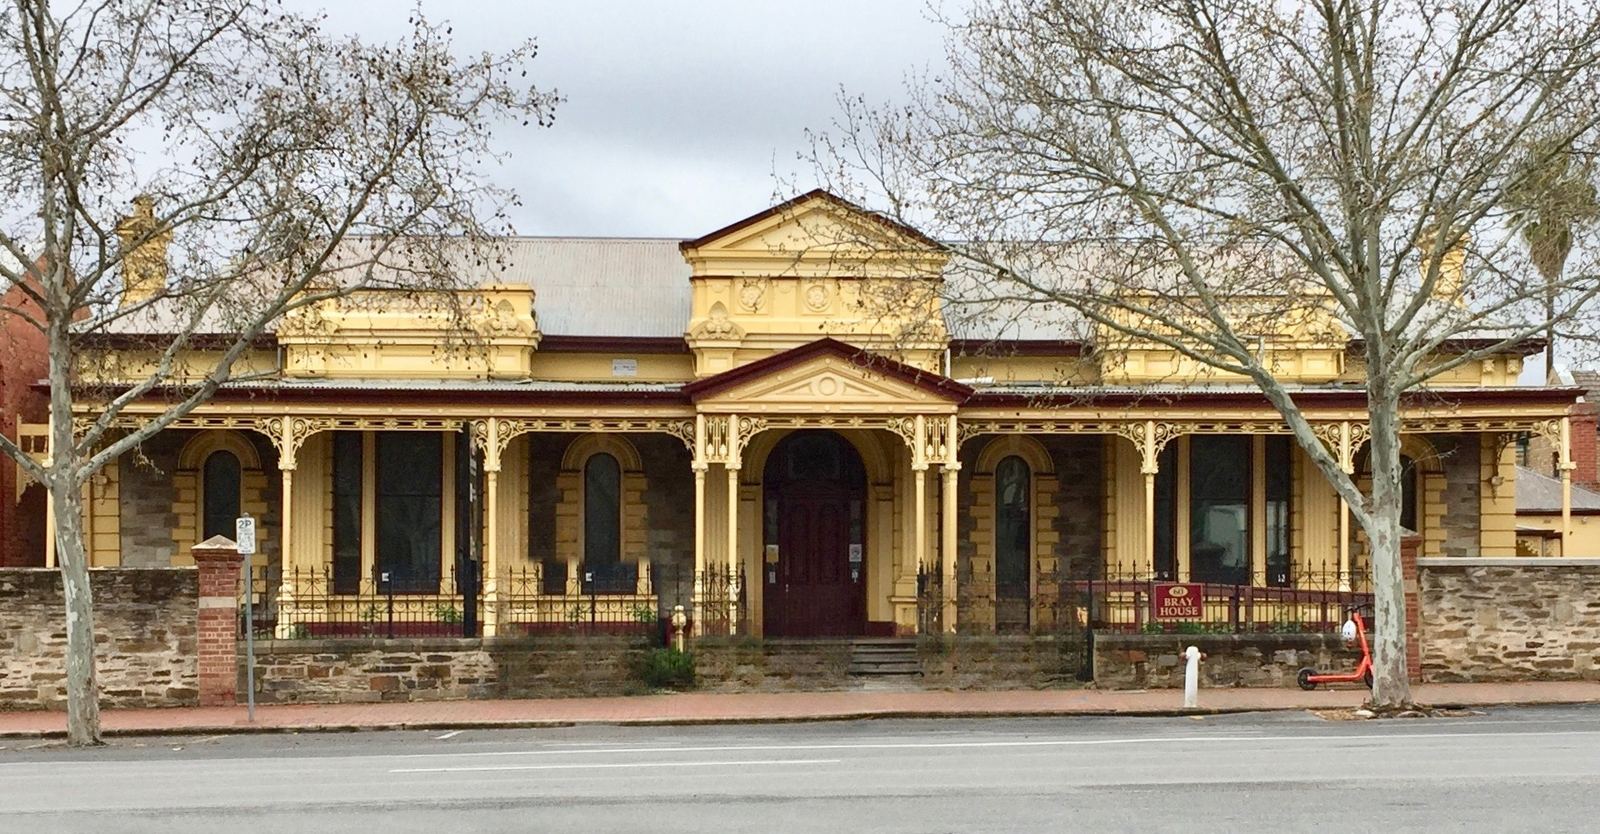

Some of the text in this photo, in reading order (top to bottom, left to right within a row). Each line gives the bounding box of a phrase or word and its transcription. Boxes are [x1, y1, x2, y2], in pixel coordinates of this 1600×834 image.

[238, 519, 252, 529] 2P
[1164, 597, 1194, 606] BRAY
[1160, 607, 1199, 616] HOUSE
